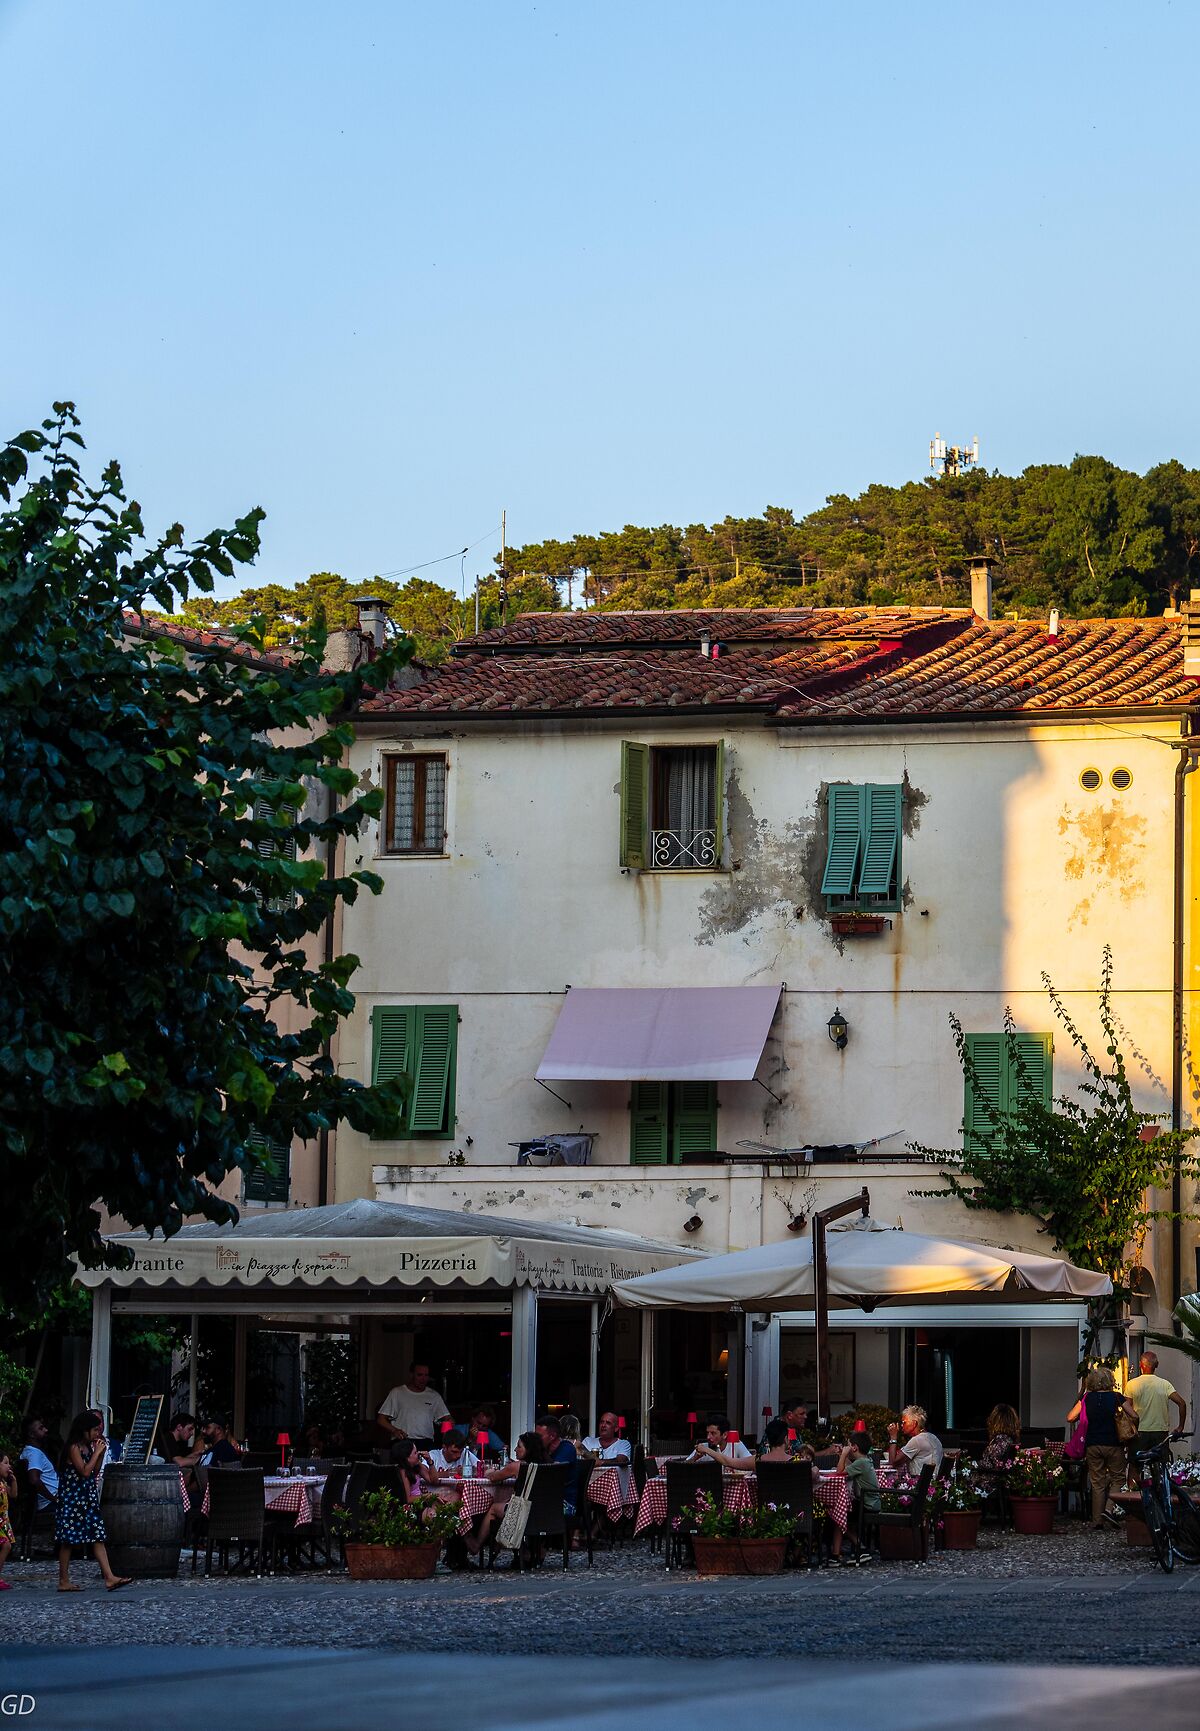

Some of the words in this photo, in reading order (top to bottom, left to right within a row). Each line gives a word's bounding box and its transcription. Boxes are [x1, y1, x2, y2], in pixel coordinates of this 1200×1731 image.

[246, 1257, 289, 1278] Piazza
[290, 1258, 303, 1275] di
[400, 1252, 477, 1271] Pizzeria
[571, 1258, 604, 1278] Trattoria
